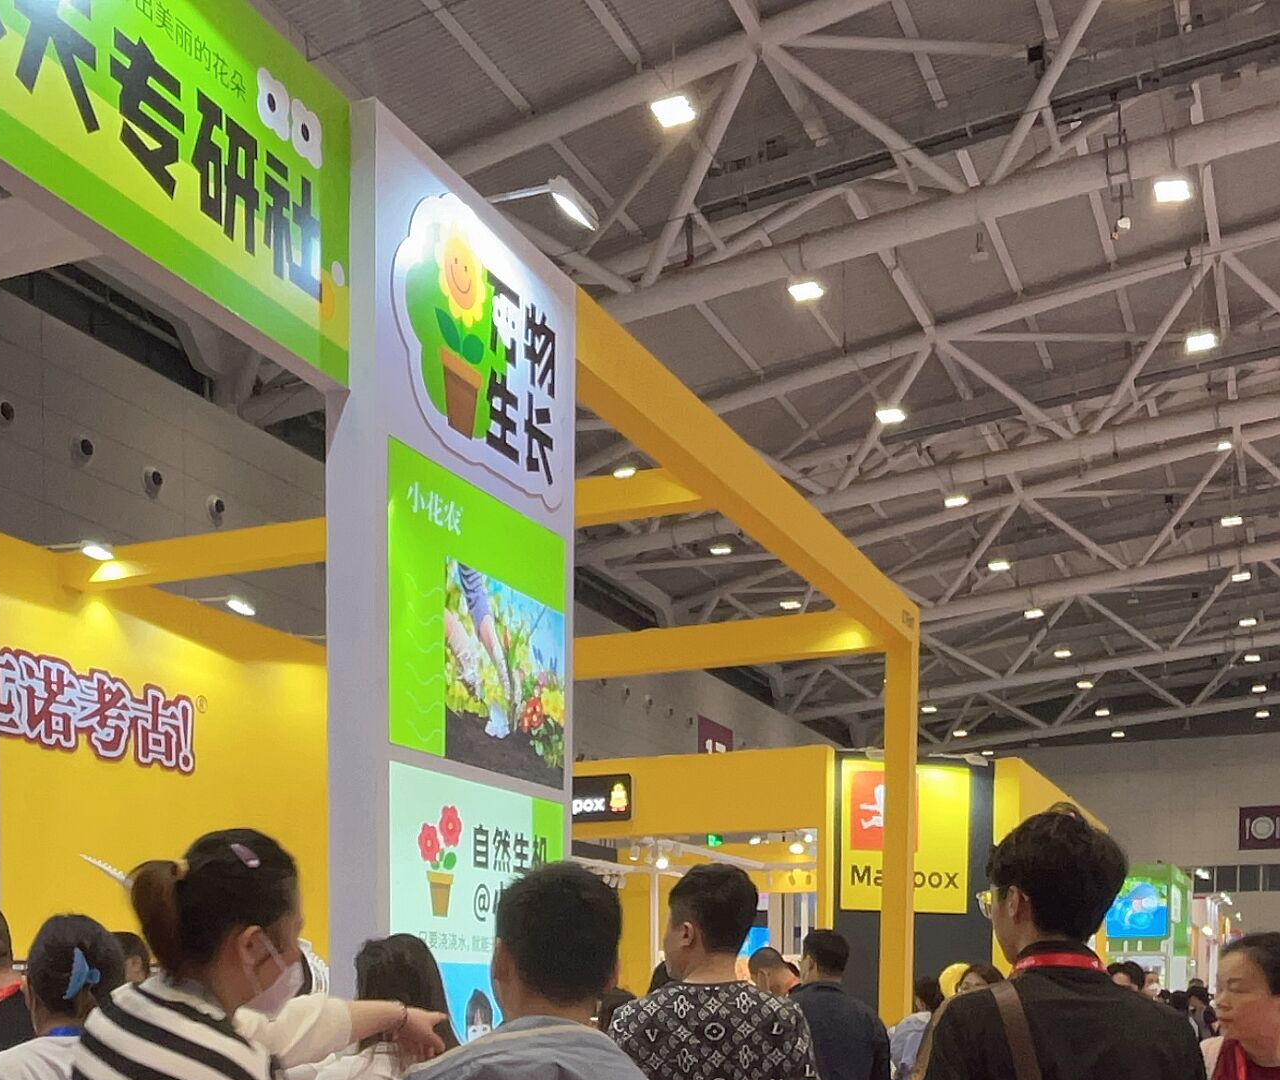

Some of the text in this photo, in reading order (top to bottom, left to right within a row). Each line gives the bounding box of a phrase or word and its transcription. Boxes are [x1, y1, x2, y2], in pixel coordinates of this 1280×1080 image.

[486, 369, 554, 486] 生长
[407, 481, 464, 536] 小花农
